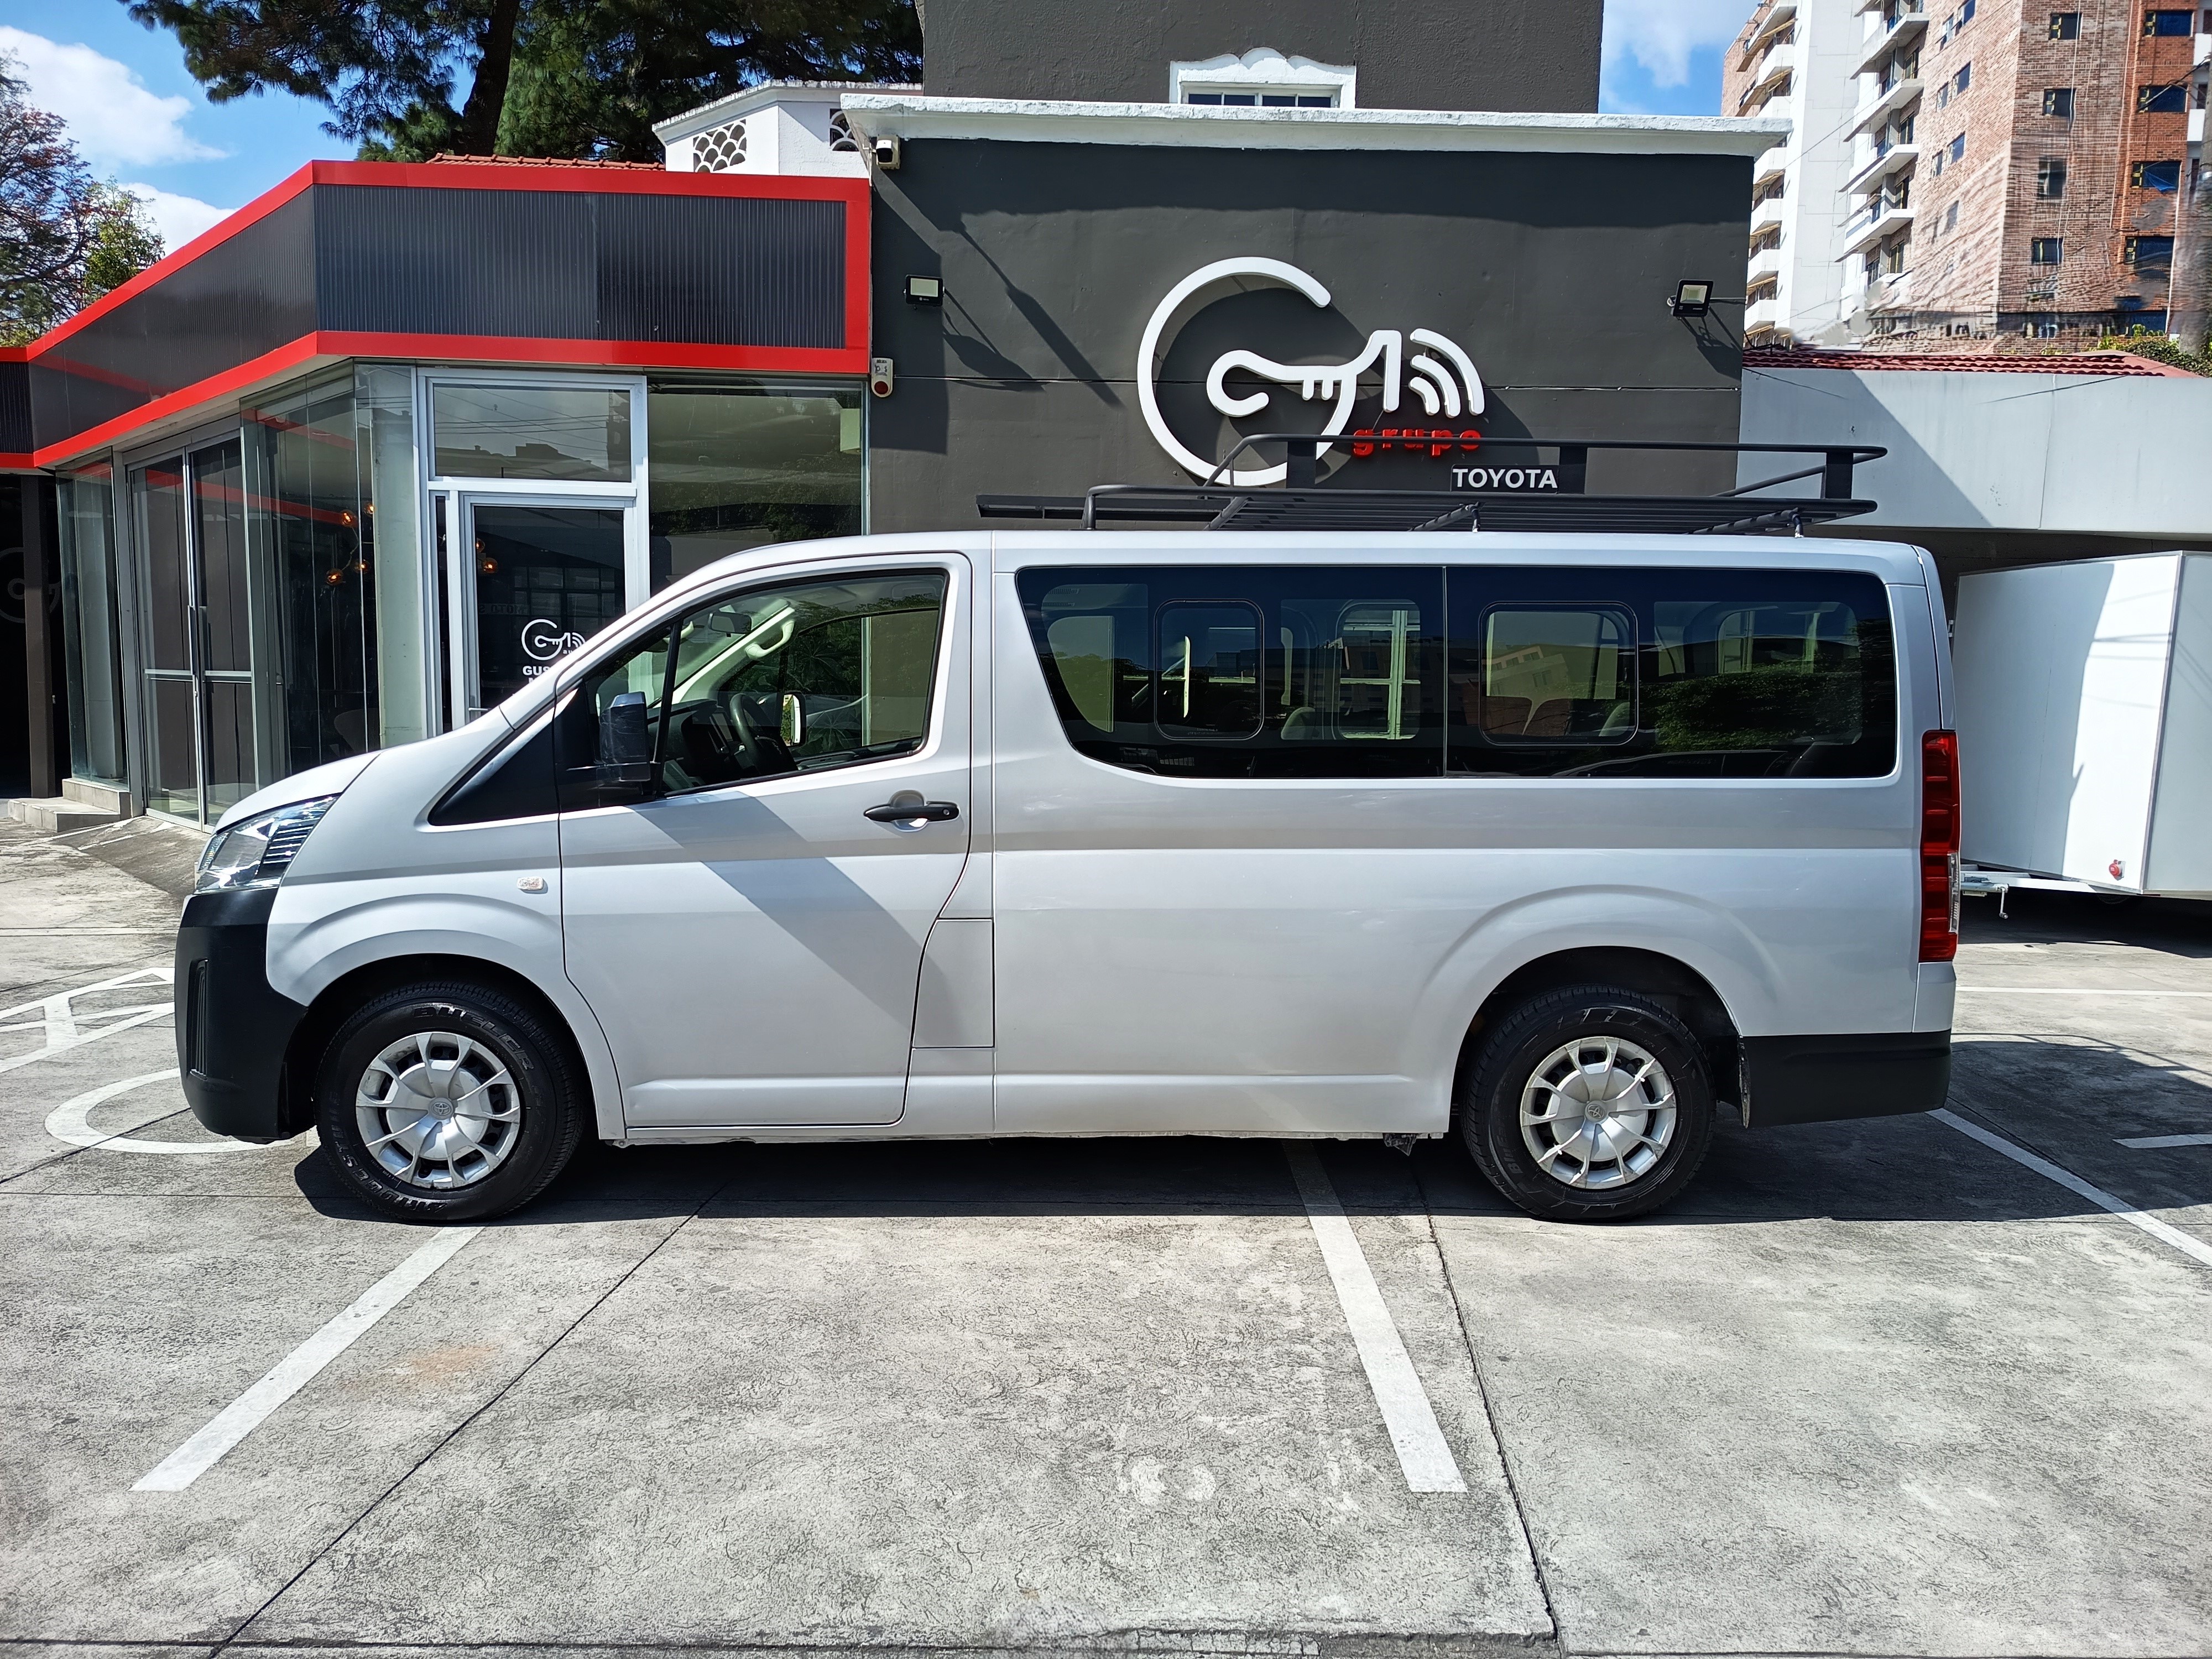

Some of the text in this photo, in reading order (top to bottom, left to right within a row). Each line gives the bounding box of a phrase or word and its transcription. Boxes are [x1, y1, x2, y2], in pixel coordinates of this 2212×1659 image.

[1353, 428, 1481, 458] grupo
[1452, 468, 1558, 489] TOYOTA
[413, 1005, 535, 1071] DUELER
